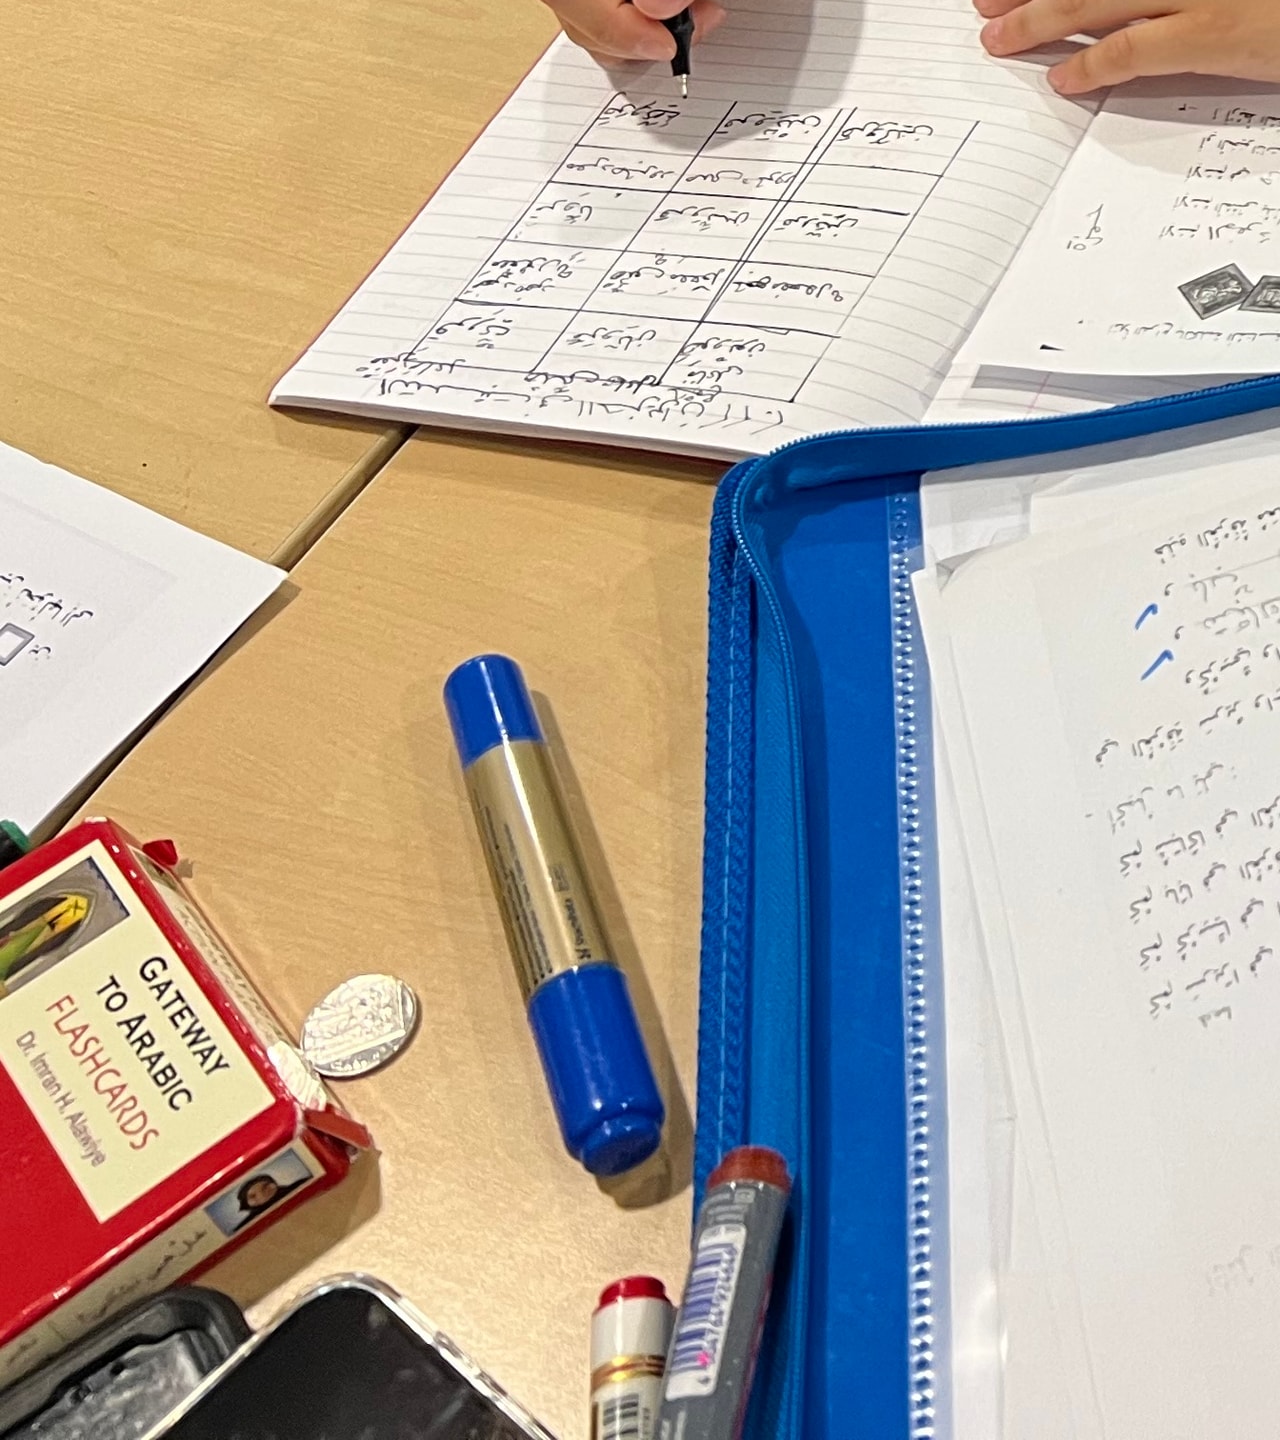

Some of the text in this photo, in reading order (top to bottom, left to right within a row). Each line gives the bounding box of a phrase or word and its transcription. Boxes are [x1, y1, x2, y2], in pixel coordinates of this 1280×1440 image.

[14, 1029, 37, 1058] Dr.
[28, 1051, 62, 1098] Imran
[43, 993, 160, 1151] FLASHCARDS
[94, 973, 193, 1112] TO ARABIC
[137, 955, 231, 1076] GATEWAY
